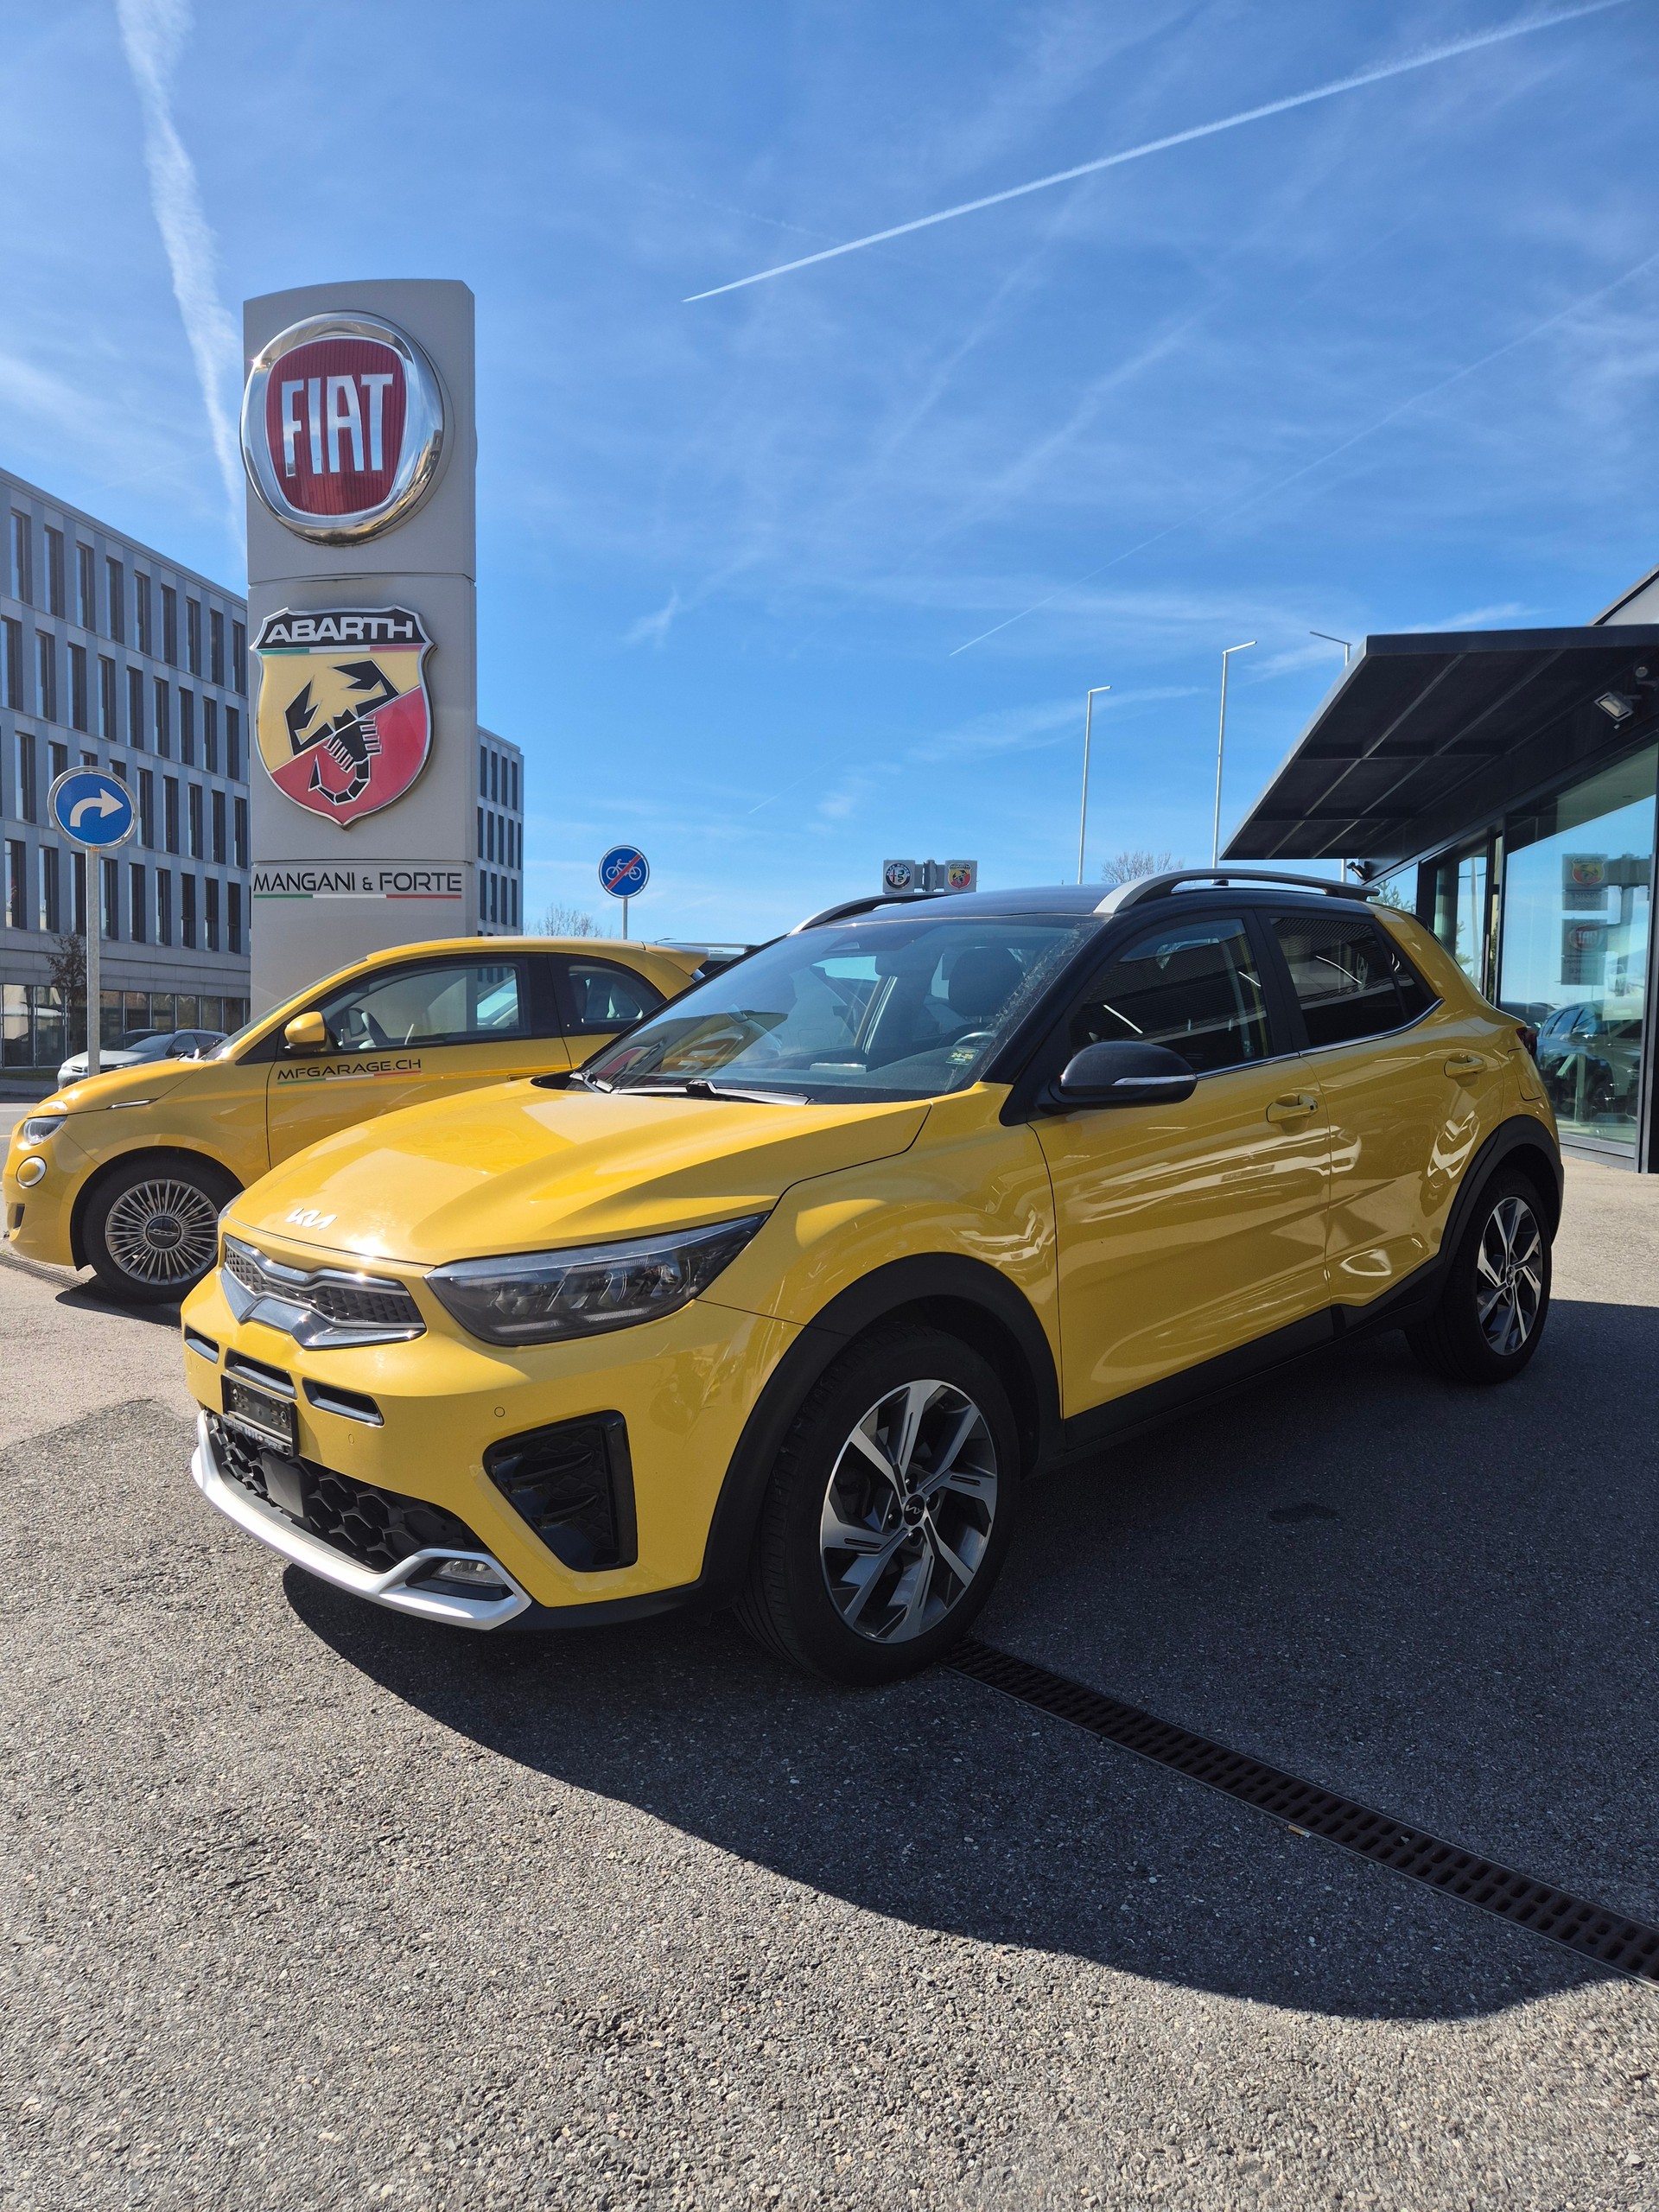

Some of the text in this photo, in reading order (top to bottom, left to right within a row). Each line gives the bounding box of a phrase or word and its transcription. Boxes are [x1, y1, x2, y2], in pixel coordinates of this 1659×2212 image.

[281, 372, 394, 477] FIAT
[265, 616, 413, 644] ABARTH
[253, 872, 462, 893] MANGANI & FORTE
[277, 1059, 422, 1080] MFGARAGE.CH
